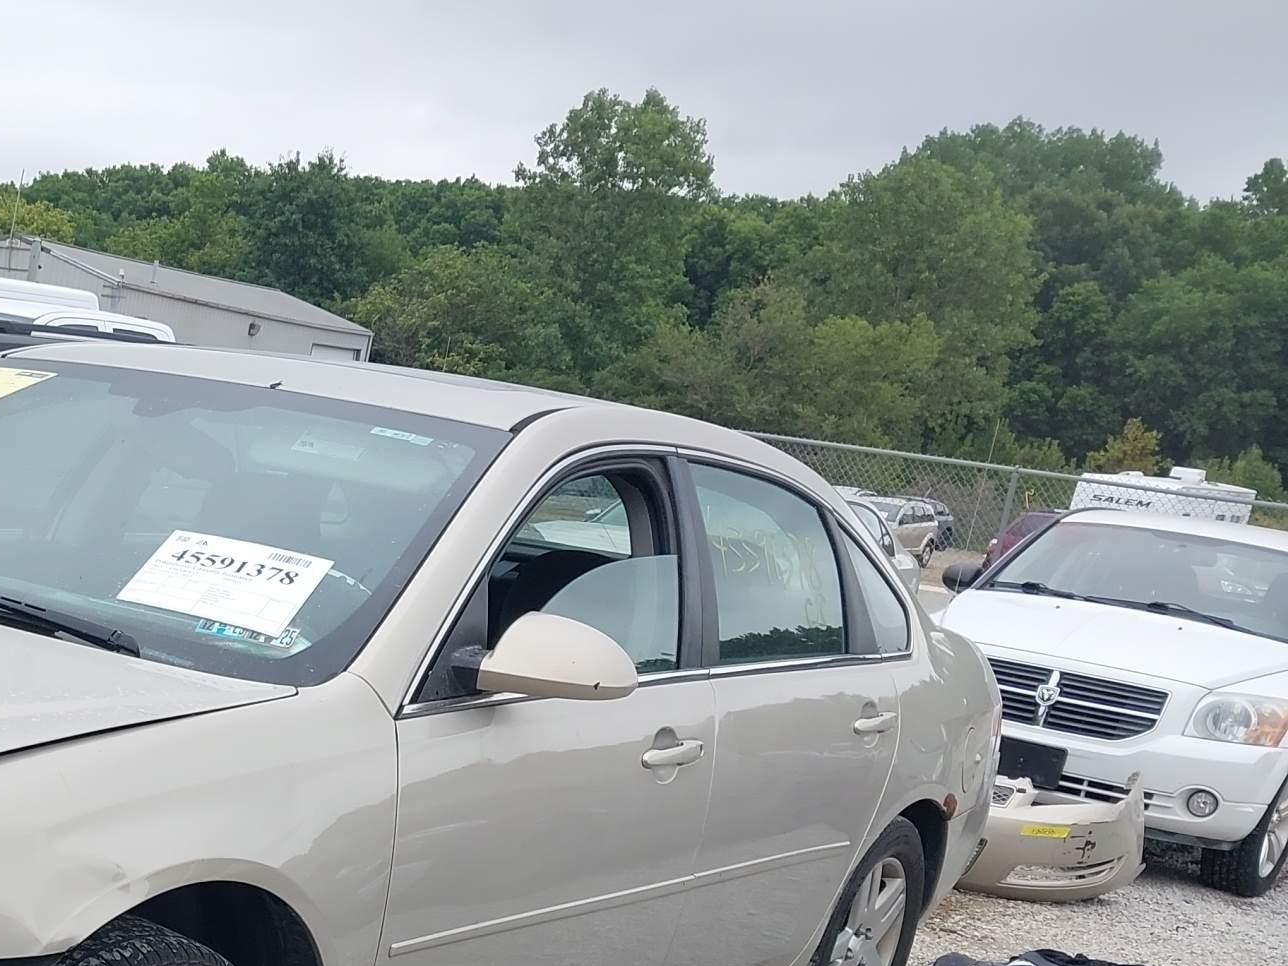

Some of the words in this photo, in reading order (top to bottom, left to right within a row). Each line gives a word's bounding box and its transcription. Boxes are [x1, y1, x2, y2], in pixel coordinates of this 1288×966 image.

[1090, 494, 1153, 509] SALEM
[171, 548, 300, 586] 45591378
[279, 628, 297, 648] 25
